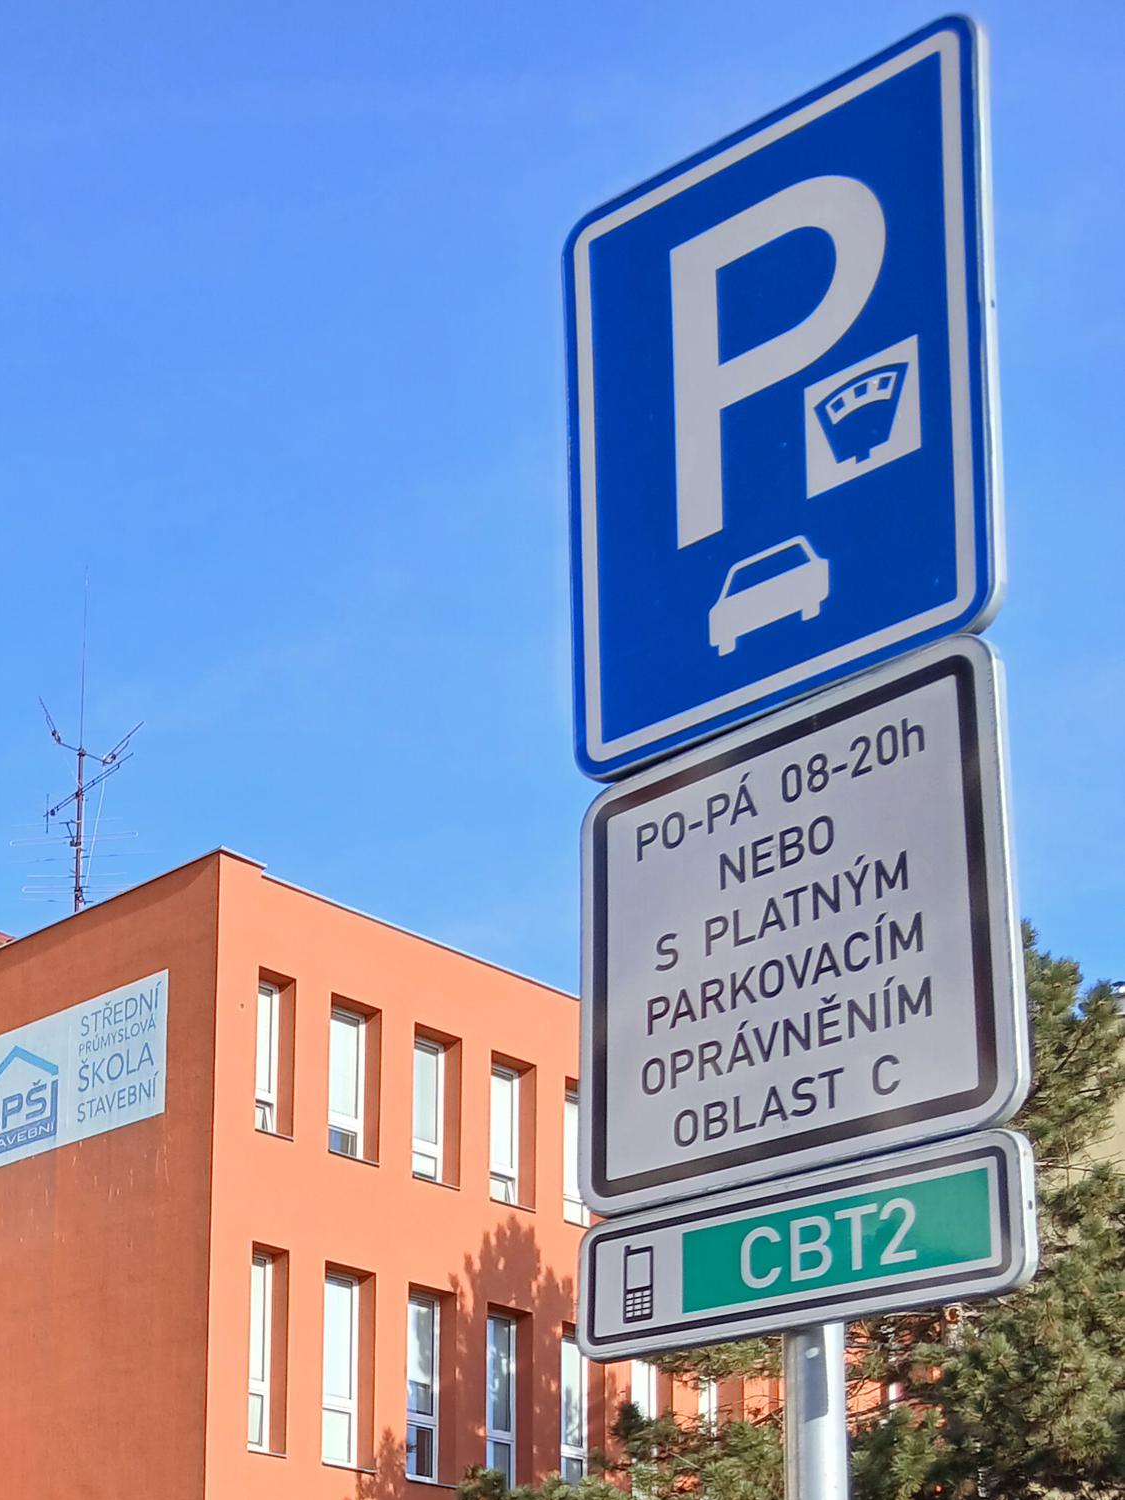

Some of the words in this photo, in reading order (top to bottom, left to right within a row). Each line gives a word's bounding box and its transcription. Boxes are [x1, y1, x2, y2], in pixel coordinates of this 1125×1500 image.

[670, 175, 886, 550] P
[636, 771, 758, 862] PO-PÁ
[781, 718, 925, 804] 08-20h
[720, 816, 835, 890] NEBO
[656, 933, 679, 972] S
[705, 850, 909, 957] PLATNÝM
[81, 981, 161, 1037] STŘEDNÍ
[647, 911, 924, 1036] PARKOVACÍM
[78, 1042, 154, 1092] ŠKOLA
[642, 976, 933, 1095] OPRÁVNĚNÍM
[77, 1071, 159, 1123] STAVEBNÍ
[674, 1067, 844, 1147] OBLAST
[872, 1055, 900, 1096] C
[741, 1197, 917, 1289] CBT2
